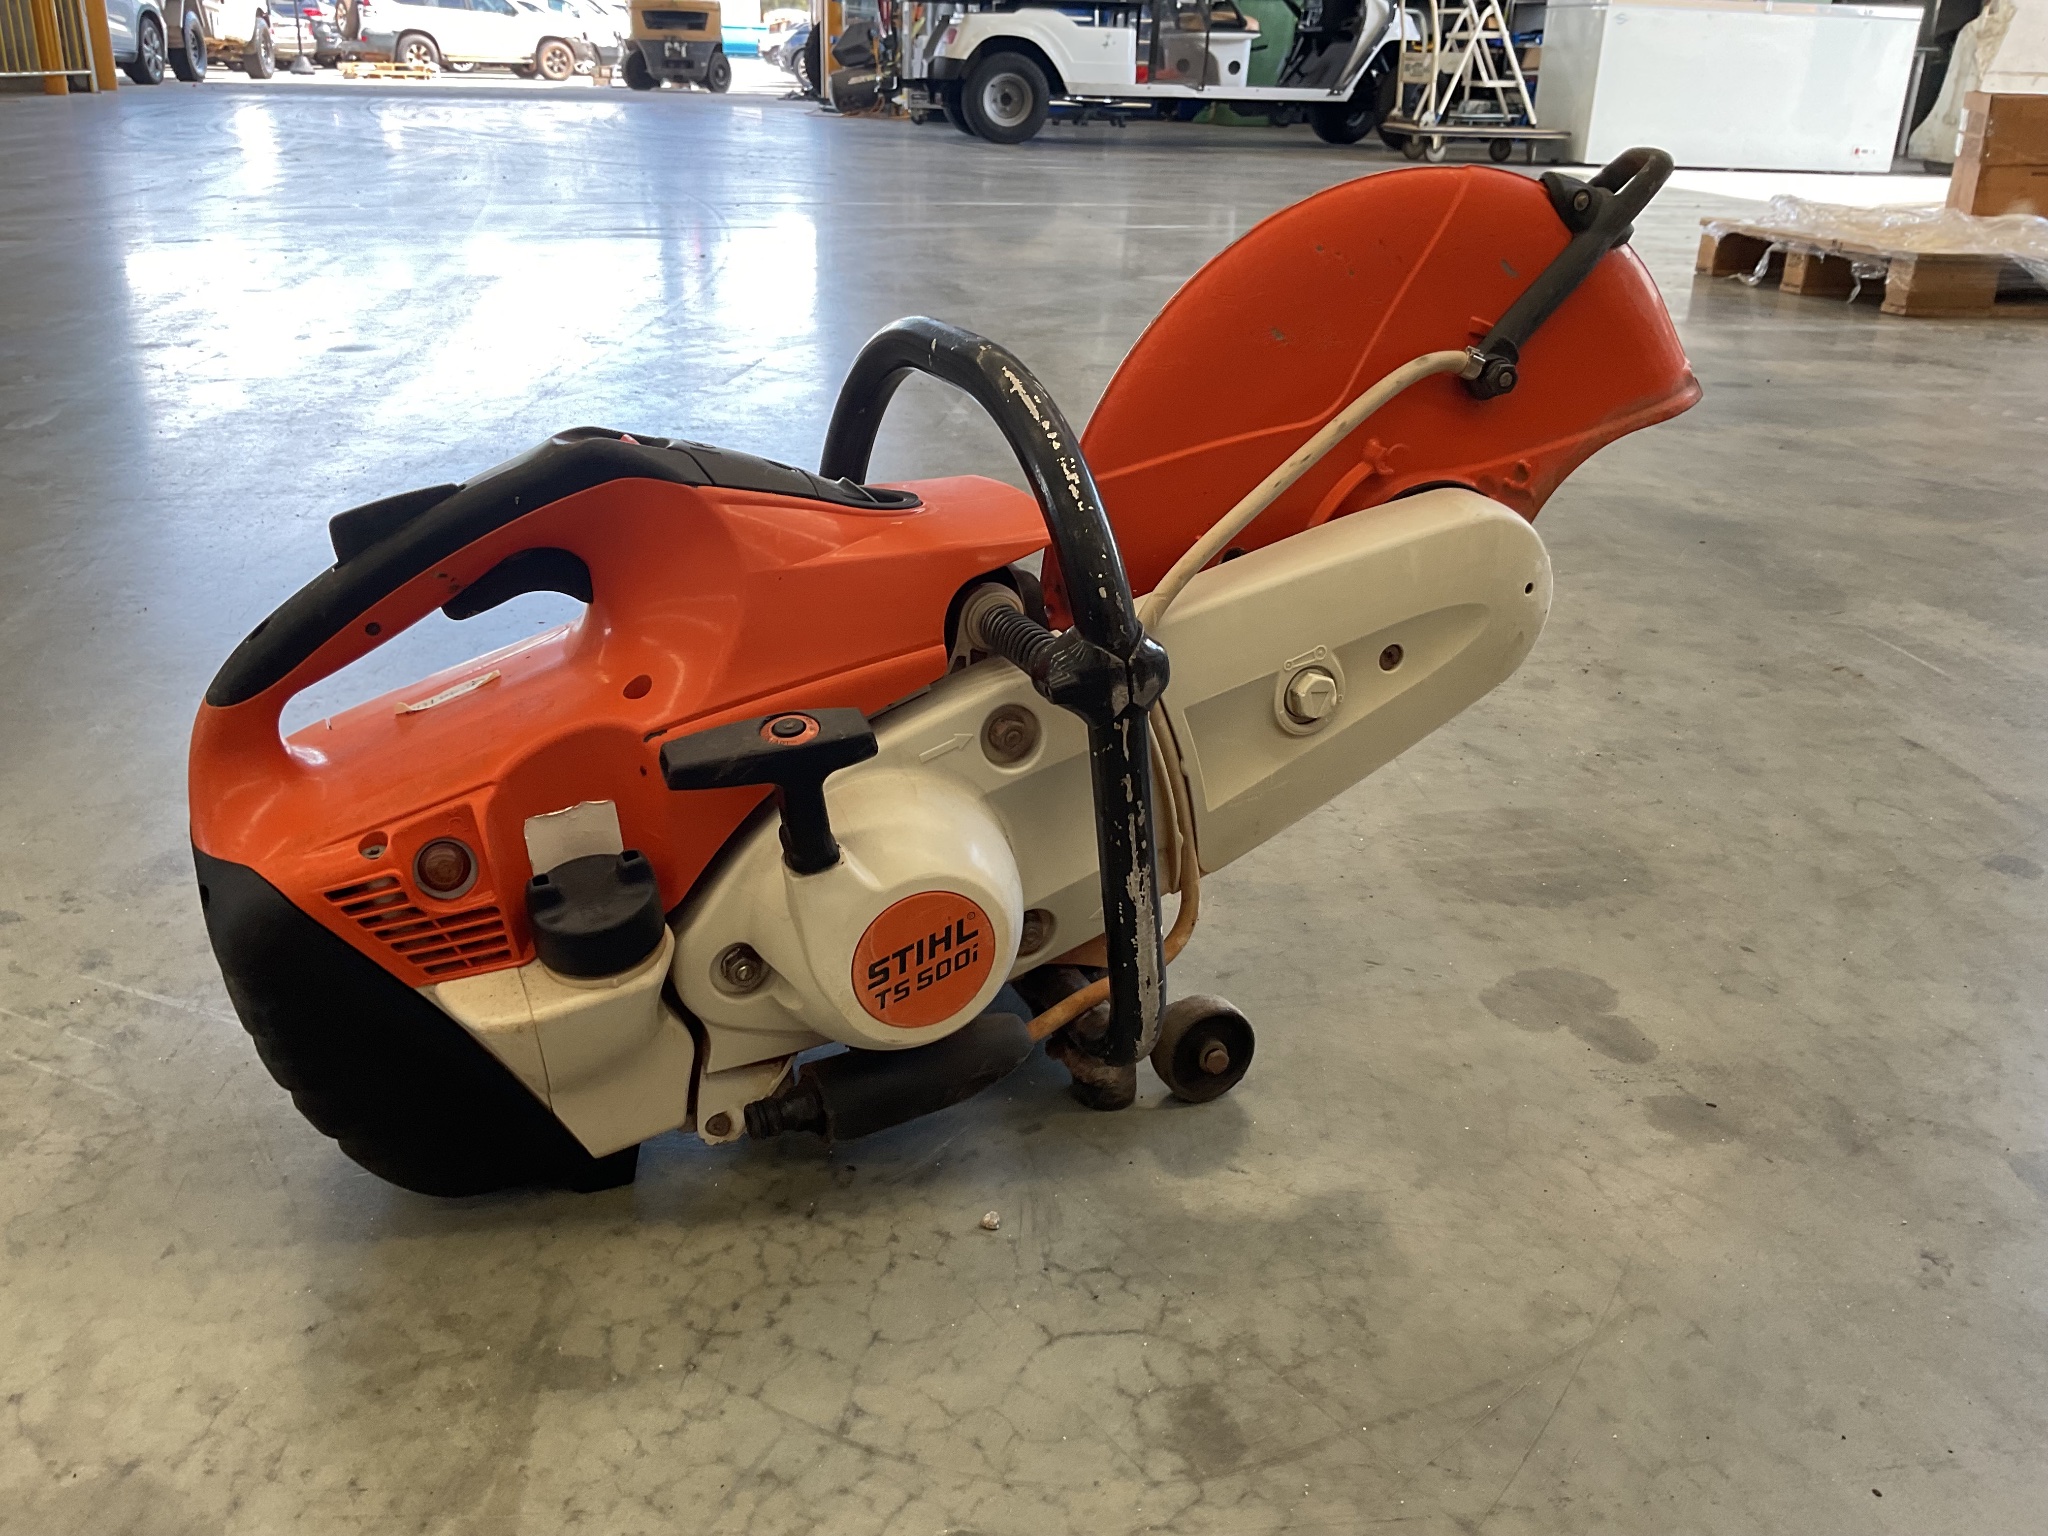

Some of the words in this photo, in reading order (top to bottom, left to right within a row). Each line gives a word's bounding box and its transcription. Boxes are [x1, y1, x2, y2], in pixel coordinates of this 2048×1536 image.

[868, 918, 979, 990] STIHL
[874, 978, 910, 1010] TS
[916, 943, 978, 991] 500i
